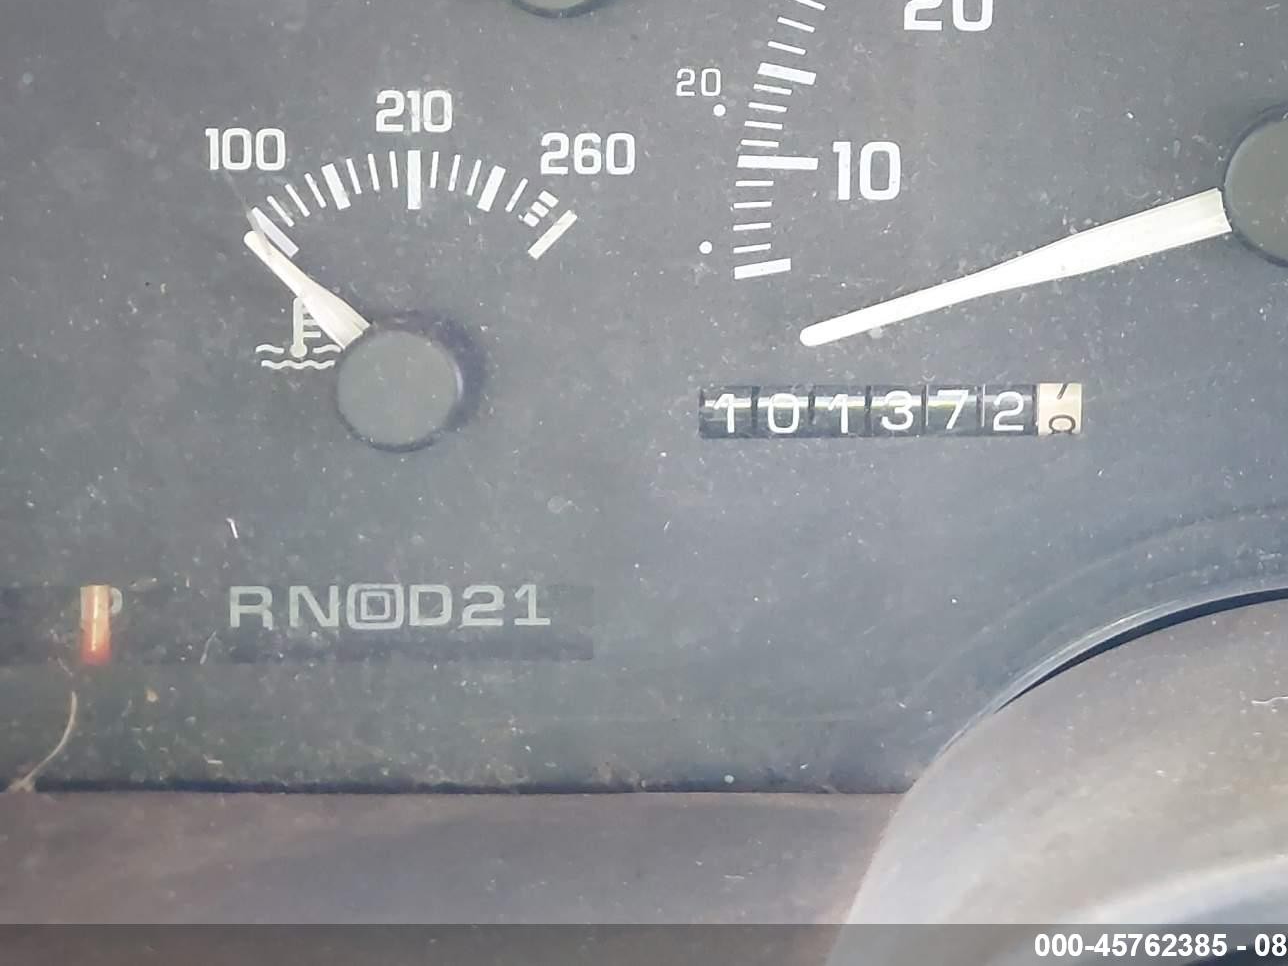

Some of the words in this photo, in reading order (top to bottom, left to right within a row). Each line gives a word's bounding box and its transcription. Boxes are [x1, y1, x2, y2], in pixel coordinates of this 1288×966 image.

[677, 69, 720, 96] 20
[376, 90, 452, 132] 210
[206, 128, 285, 170] 100
[541, 133, 635, 174] 260
[833, 142, 900, 200] 10
